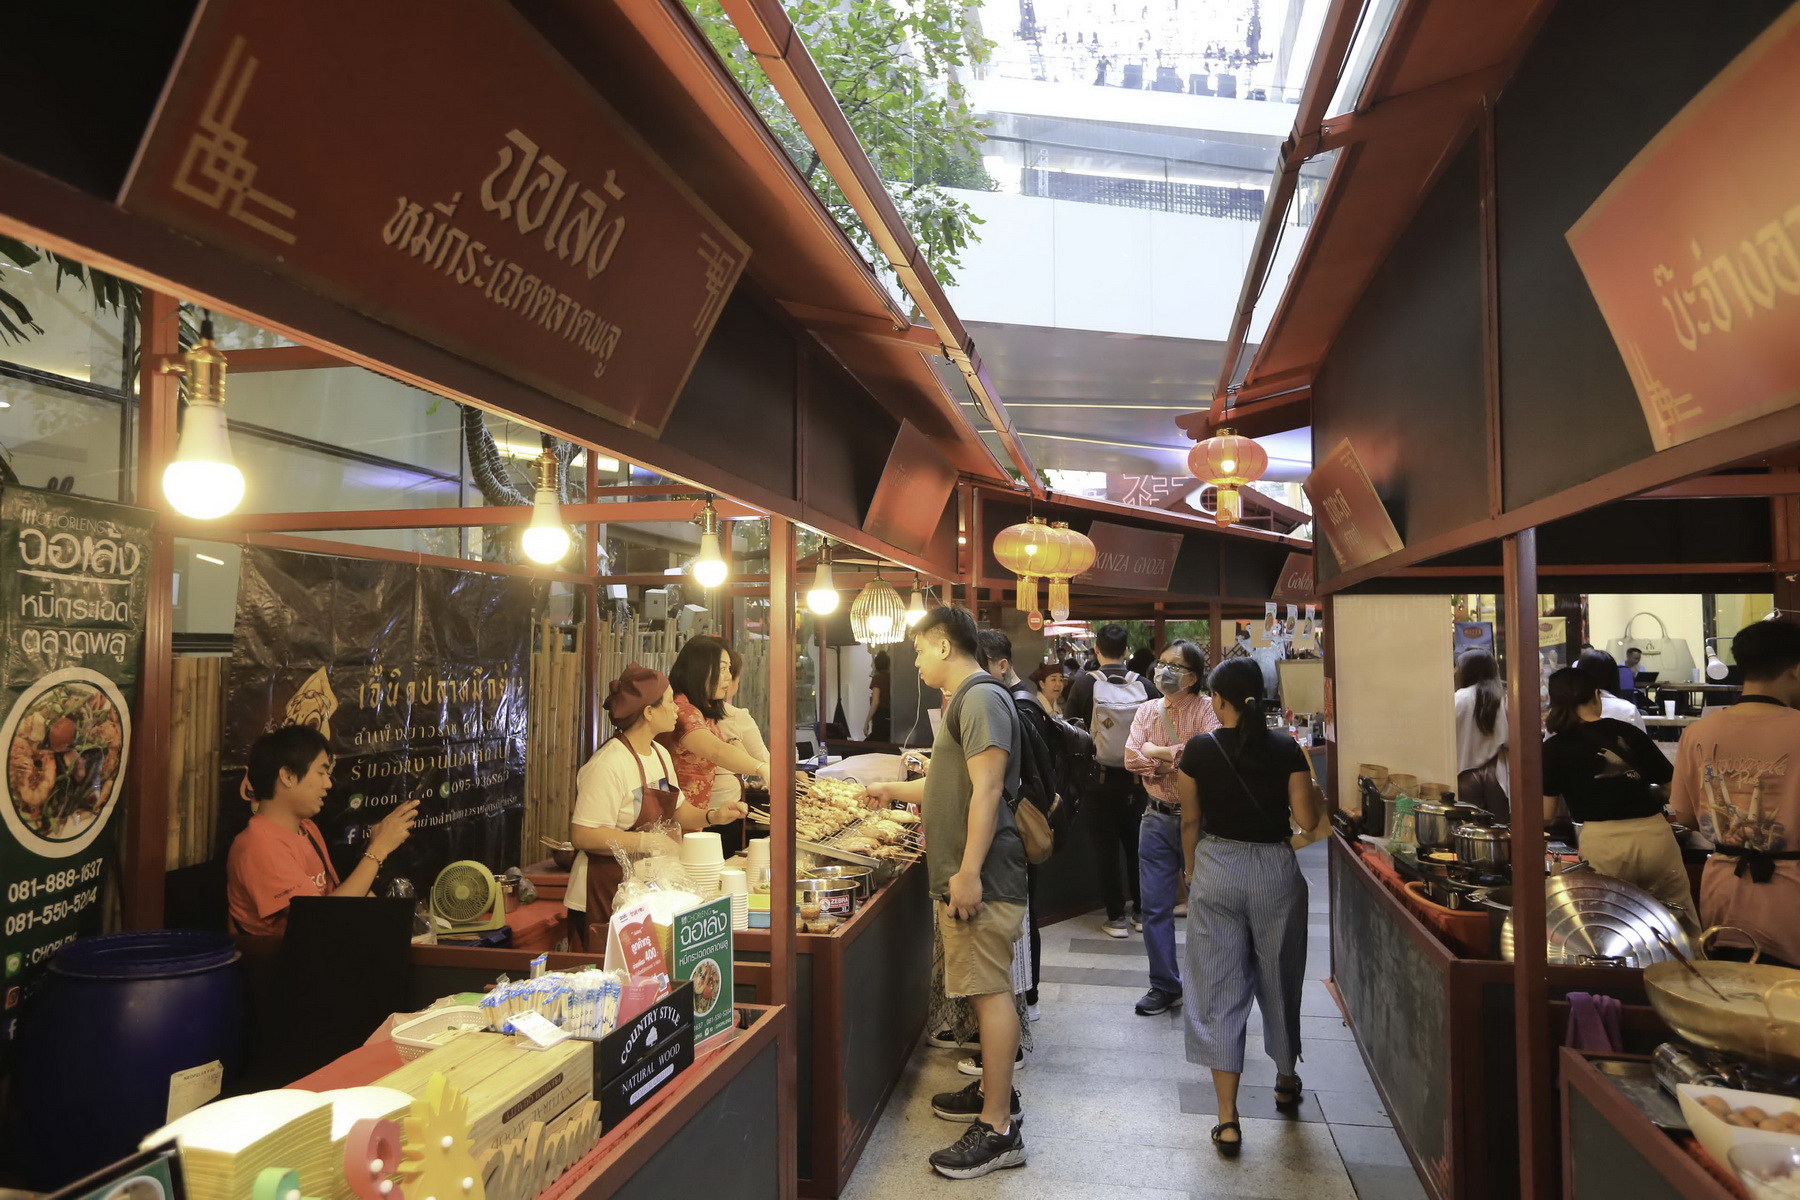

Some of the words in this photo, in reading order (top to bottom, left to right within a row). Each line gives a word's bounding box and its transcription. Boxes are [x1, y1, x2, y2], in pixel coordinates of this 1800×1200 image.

[480, 127, 626, 281] ฉอเล้ง
[382, 191, 623, 379] หมี่กระเฉดตลาดพลู
[19, 524, 140, 576] ฉอเล้ง
[1133, 556, 1166, 575] GYOZA
[21, 583, 128, 622] หมี่กระเฉด
[21, 628, 127, 663] ตลาดพลู
[8, 857, 103, 903] 081-888-1637
[680, 909, 728, 946] ฉอเล้ง
[621, 1008, 658, 1065] COUNTRY
[660, 1006, 680, 1027] STYLE
[622, 1062, 655, 1094] NATURAL
[658, 1043, 680, 1066] WOOD
